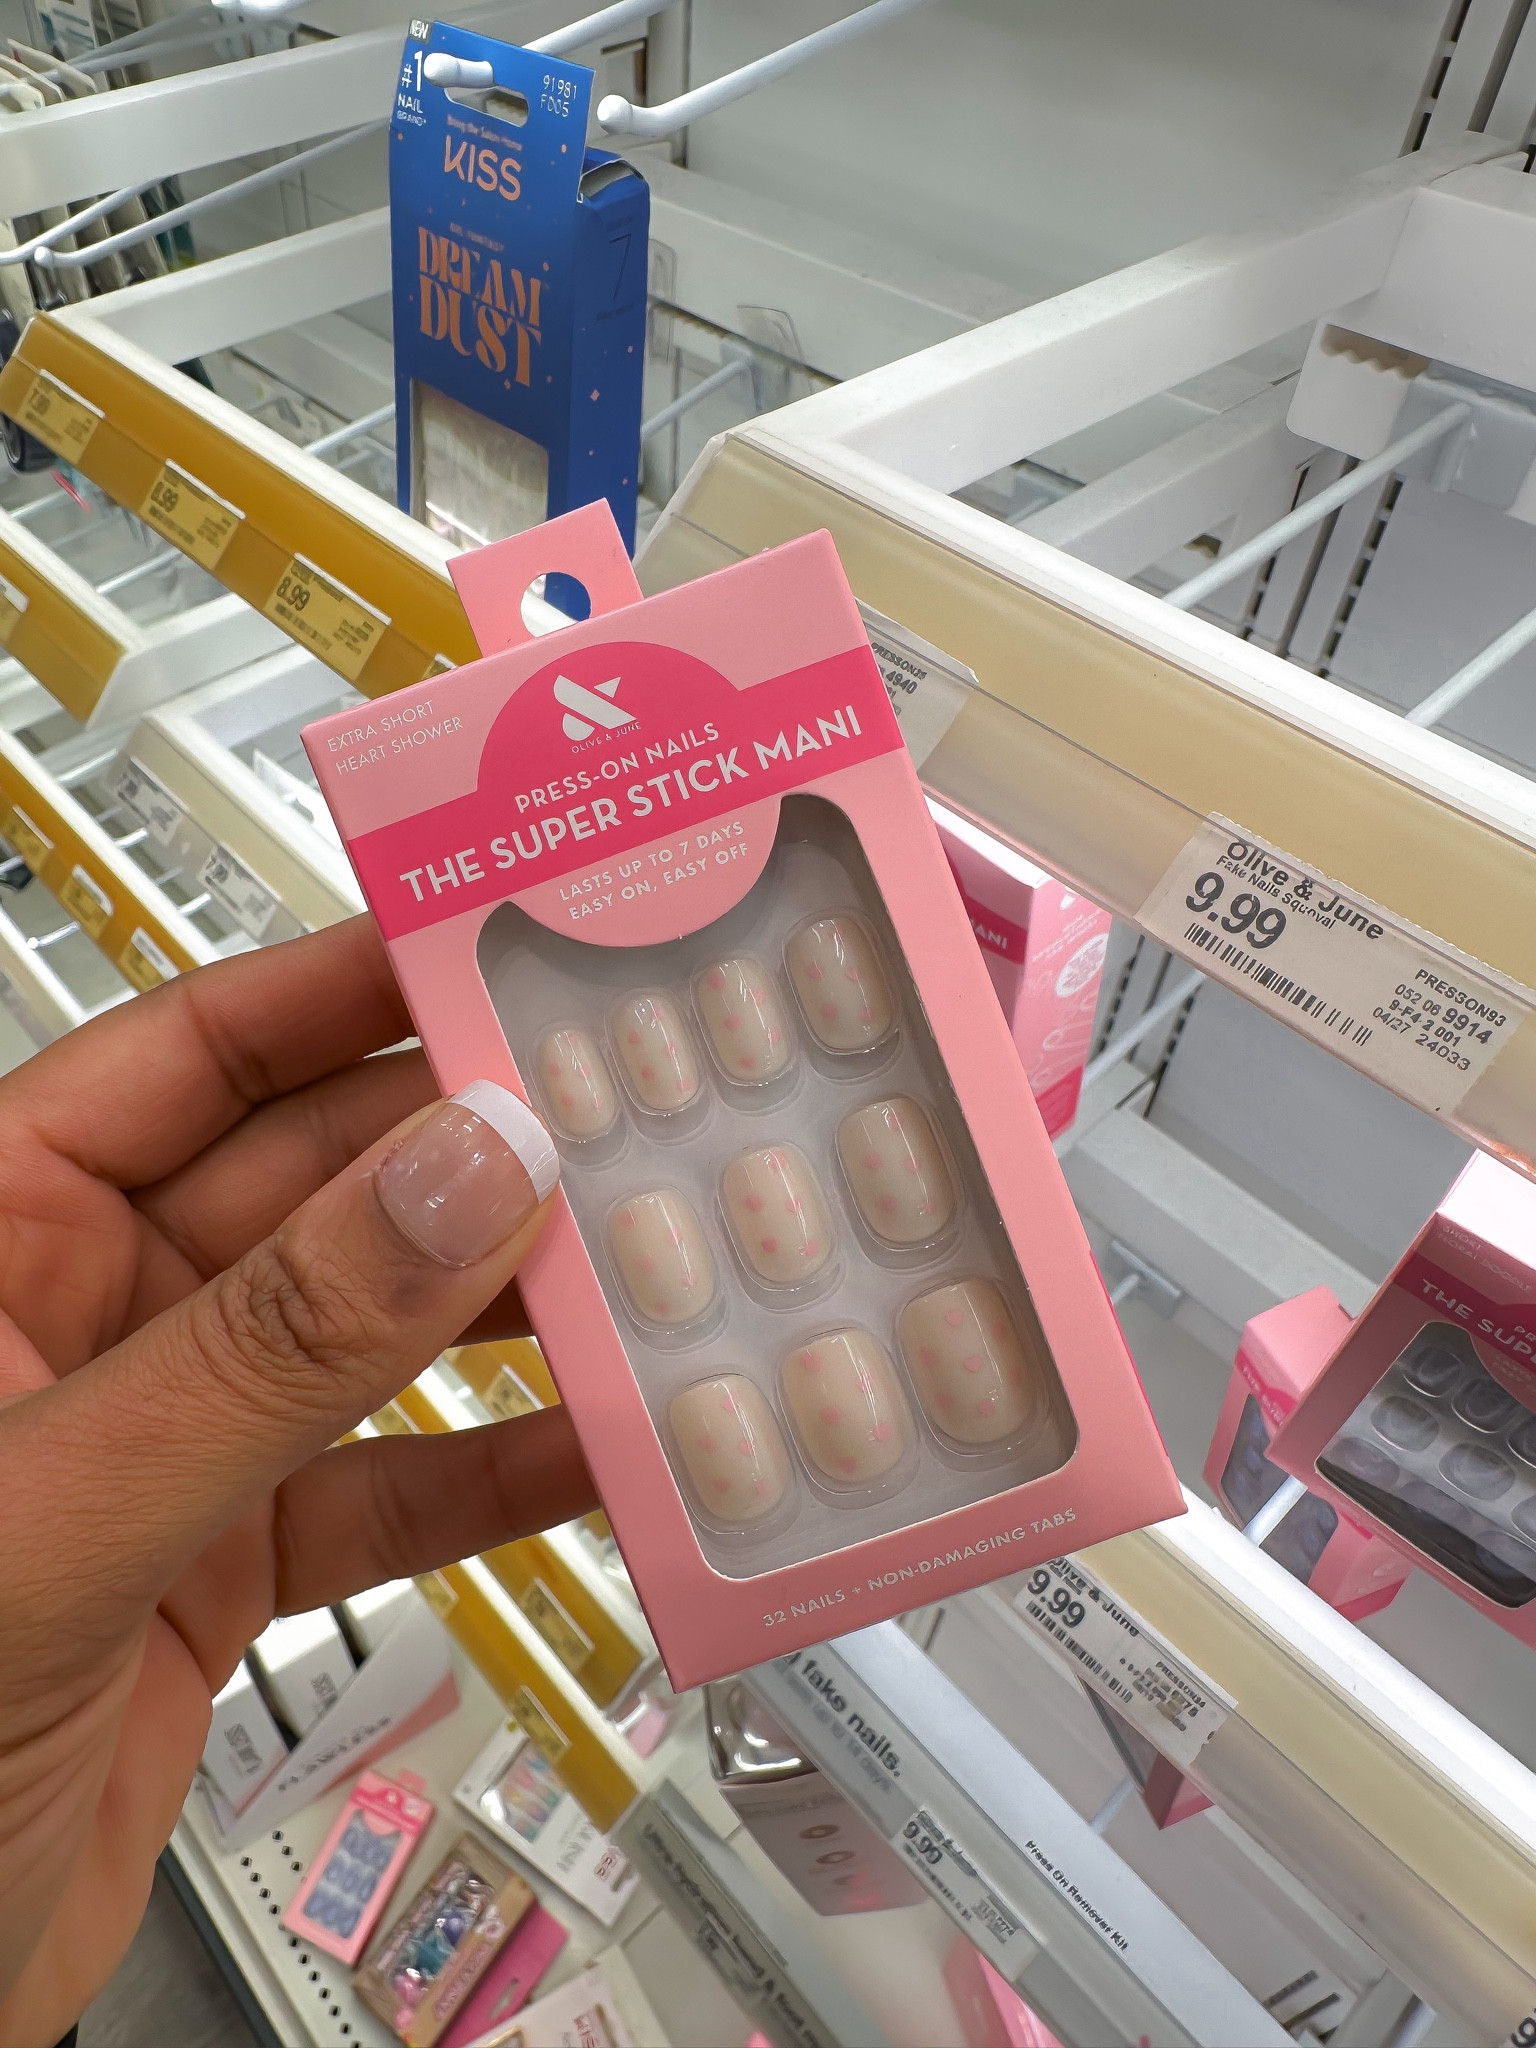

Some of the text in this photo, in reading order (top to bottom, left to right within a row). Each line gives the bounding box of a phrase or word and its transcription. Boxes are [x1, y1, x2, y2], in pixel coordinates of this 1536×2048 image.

[410, 20, 428, 39] NEW
[402, 50, 423, 91] #1
[543, 74, 577, 100] 91981
[398, 93, 423, 114] NAIL
[444, 134, 522, 201] KISS
[418, 226, 541, 327] DREAM
[420, 274, 542, 387] DUST
[276, 576, 311, 612] 8.99
[327, 699, 433, 752] EXTRA SHORT
[335, 716, 464, 776] HEART SHOWER
[571, 721, 641, 754] OLIVE & JUNE
[515, 722, 719, 814] PRESS-ON NAILS
[399, 705, 862, 902] THE SUPER STICK MANI
[559, 821, 744, 901] LASTS UP TO 7 DAYS
[569, 842, 748, 920] EASY ON, EASY OFF
[1216, 855, 1247, 879] Fake
[1248, 873, 1281, 898] Nails
[1227, 841, 1384, 940] Olive & June
[1185, 871, 1287, 949] 9.99
[1394, 983, 1422, 1005] 052
[1442, 1007, 1493, 1045] 9914
[1415, 968, 1507, 1027] PRESSON93
[1372, 1006, 1471, 1071] 04/27 24033
[1434, 1026, 1461, 1048] 001
[1422, 1278, 1474, 1320] THE
[763, 1611, 787, 1628] 32
[789, 1588, 847, 1618] NAILS
[851, 1586, 861, 1596] +
[868, 1527, 1026, 1591] NON-DAMAGING
[1030, 1507, 1077, 1535] TABS
[1027, 1569, 1086, 1629] 9.99
[1101, 1602, 1140, 1638] June
[802, 1660, 901, 1778] fake nails.
[1025, 1840, 1129, 1952] Press On Remover Kit
